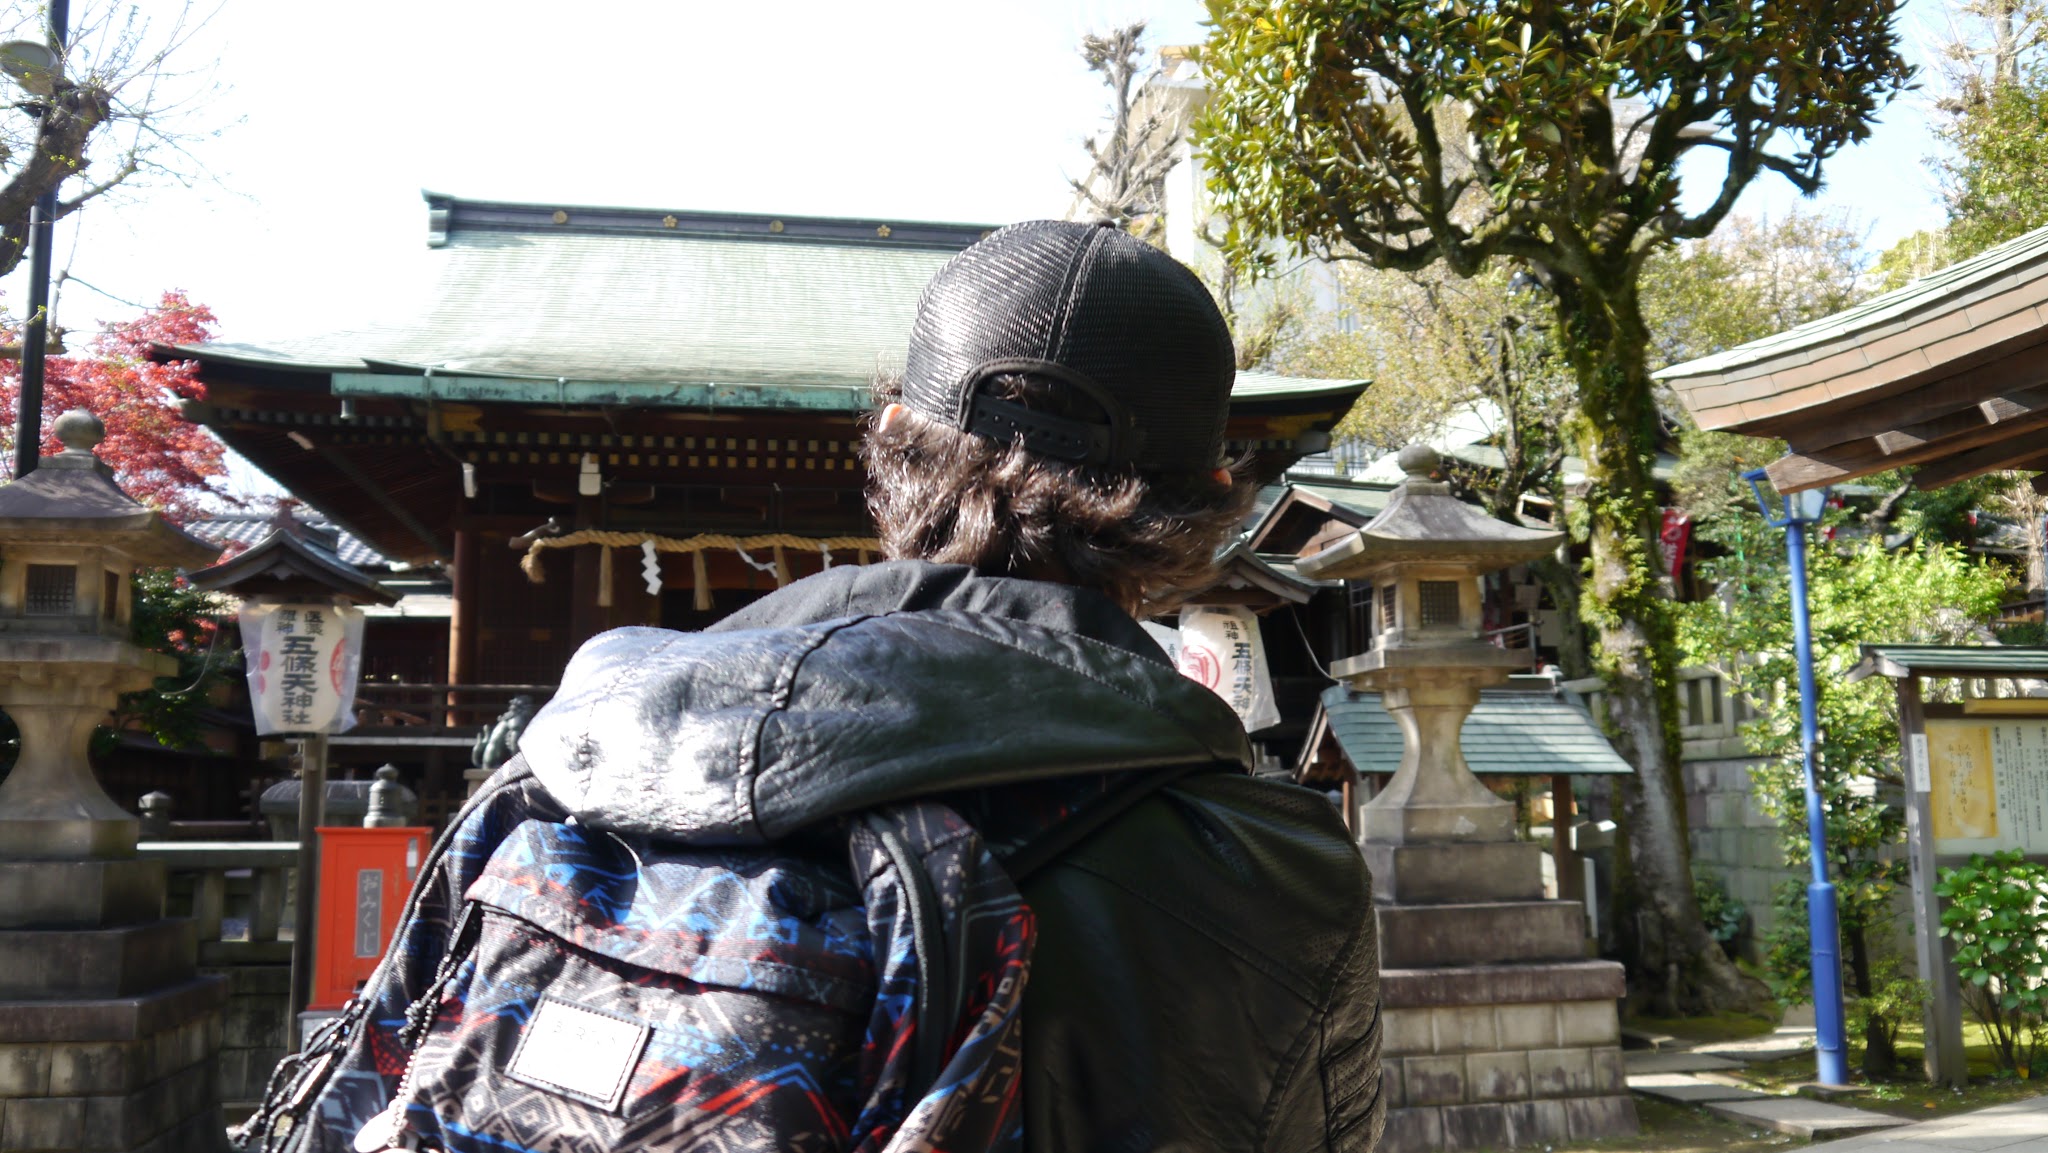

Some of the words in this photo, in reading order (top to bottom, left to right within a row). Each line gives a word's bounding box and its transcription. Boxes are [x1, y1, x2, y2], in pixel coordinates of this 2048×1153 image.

[1222, 620, 1239, 640] 祖神
[360, 874, 378, 953] おみくじ
